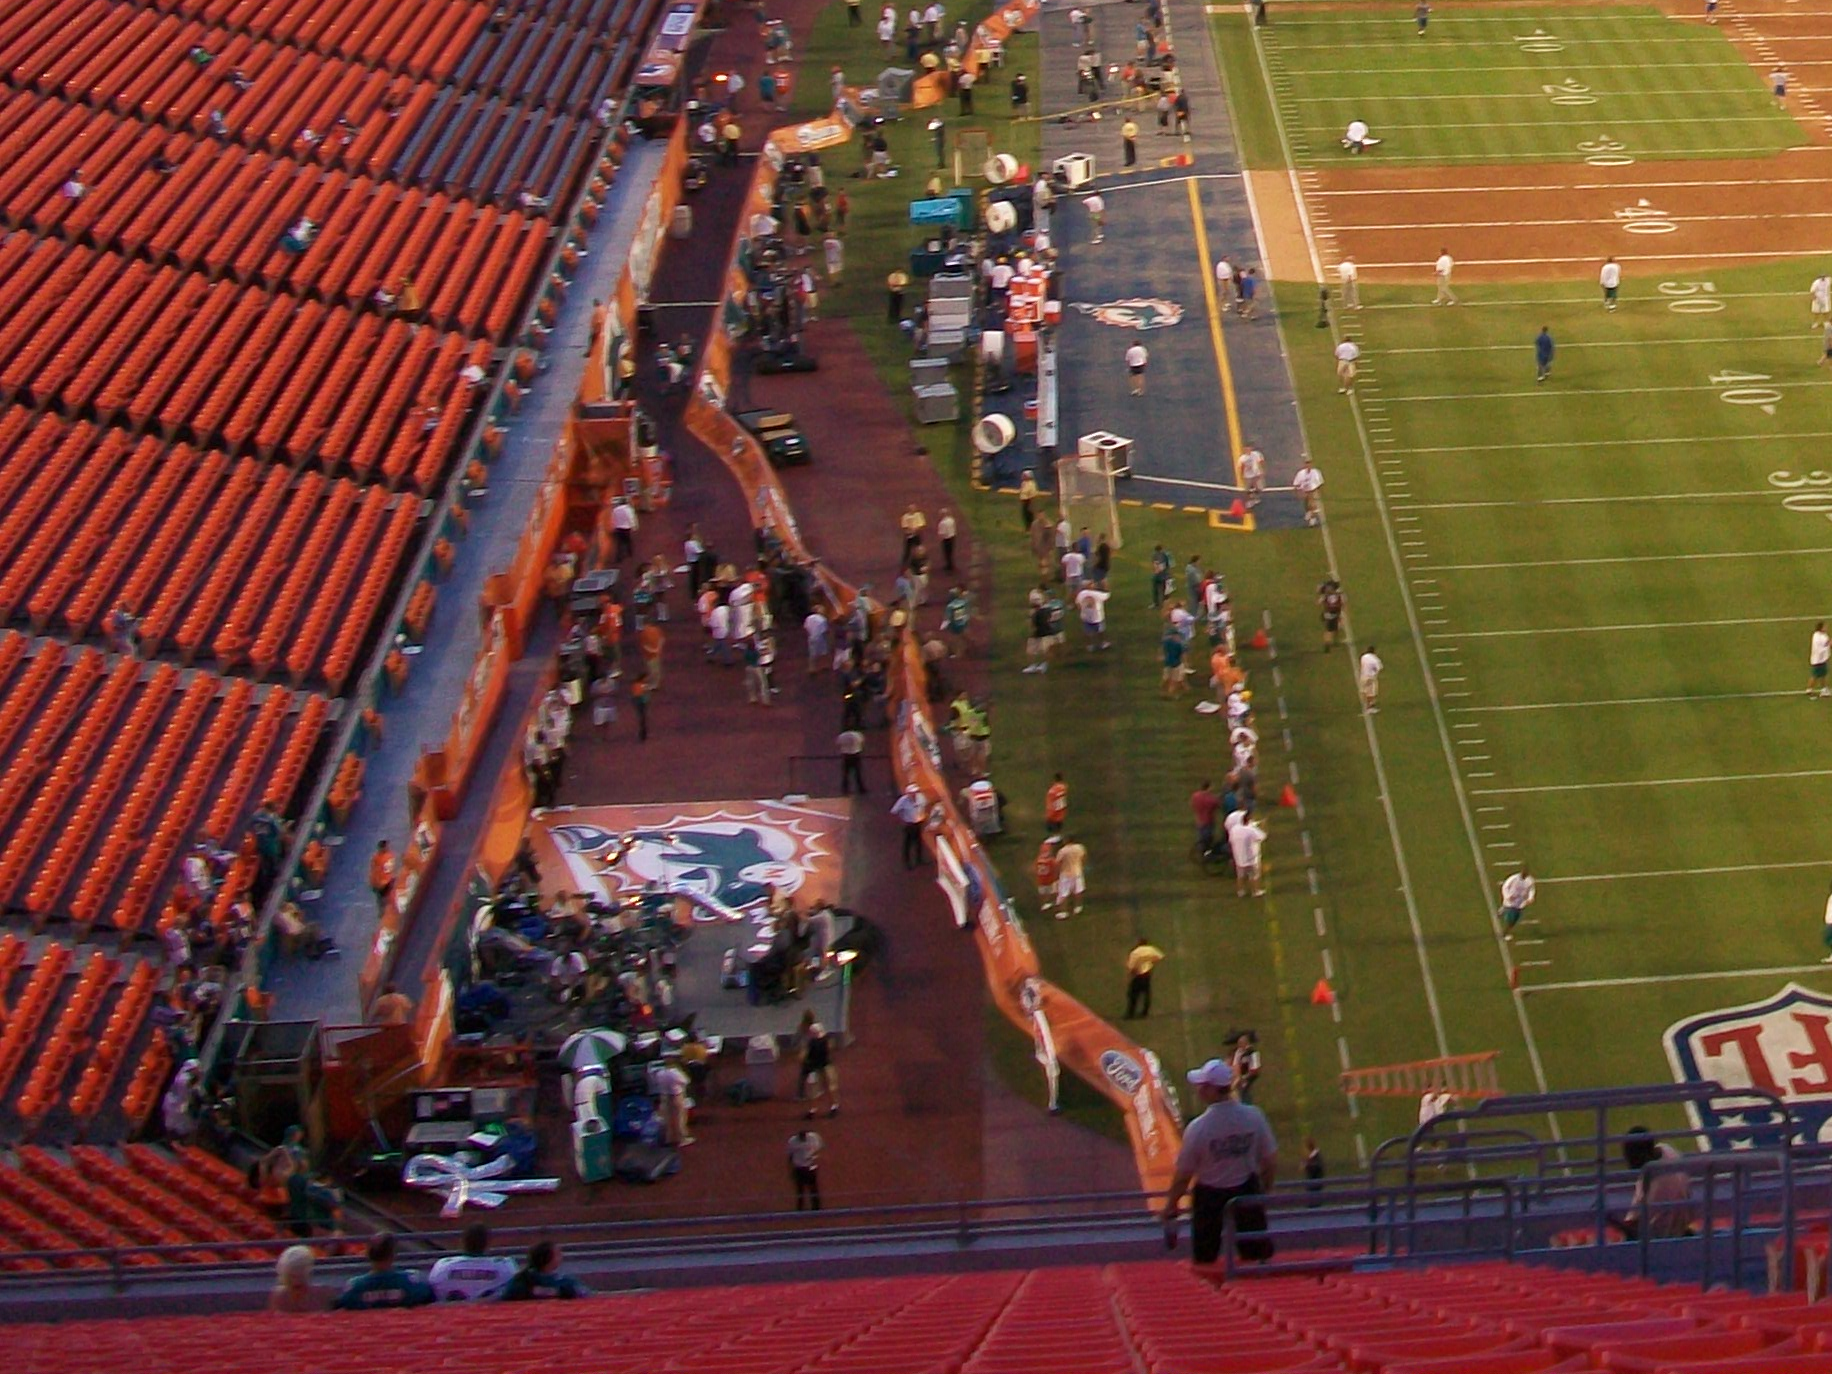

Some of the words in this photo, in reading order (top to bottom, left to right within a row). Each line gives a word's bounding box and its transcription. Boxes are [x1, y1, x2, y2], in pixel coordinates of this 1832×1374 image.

[1541, 85, 1599, 105] 20
[1576, 141, 1636, 166] 30
[1614, 207, 1678, 233] 40
[1658, 282, 1726, 313] 50
[1708, 369, 1783, 405] 40
